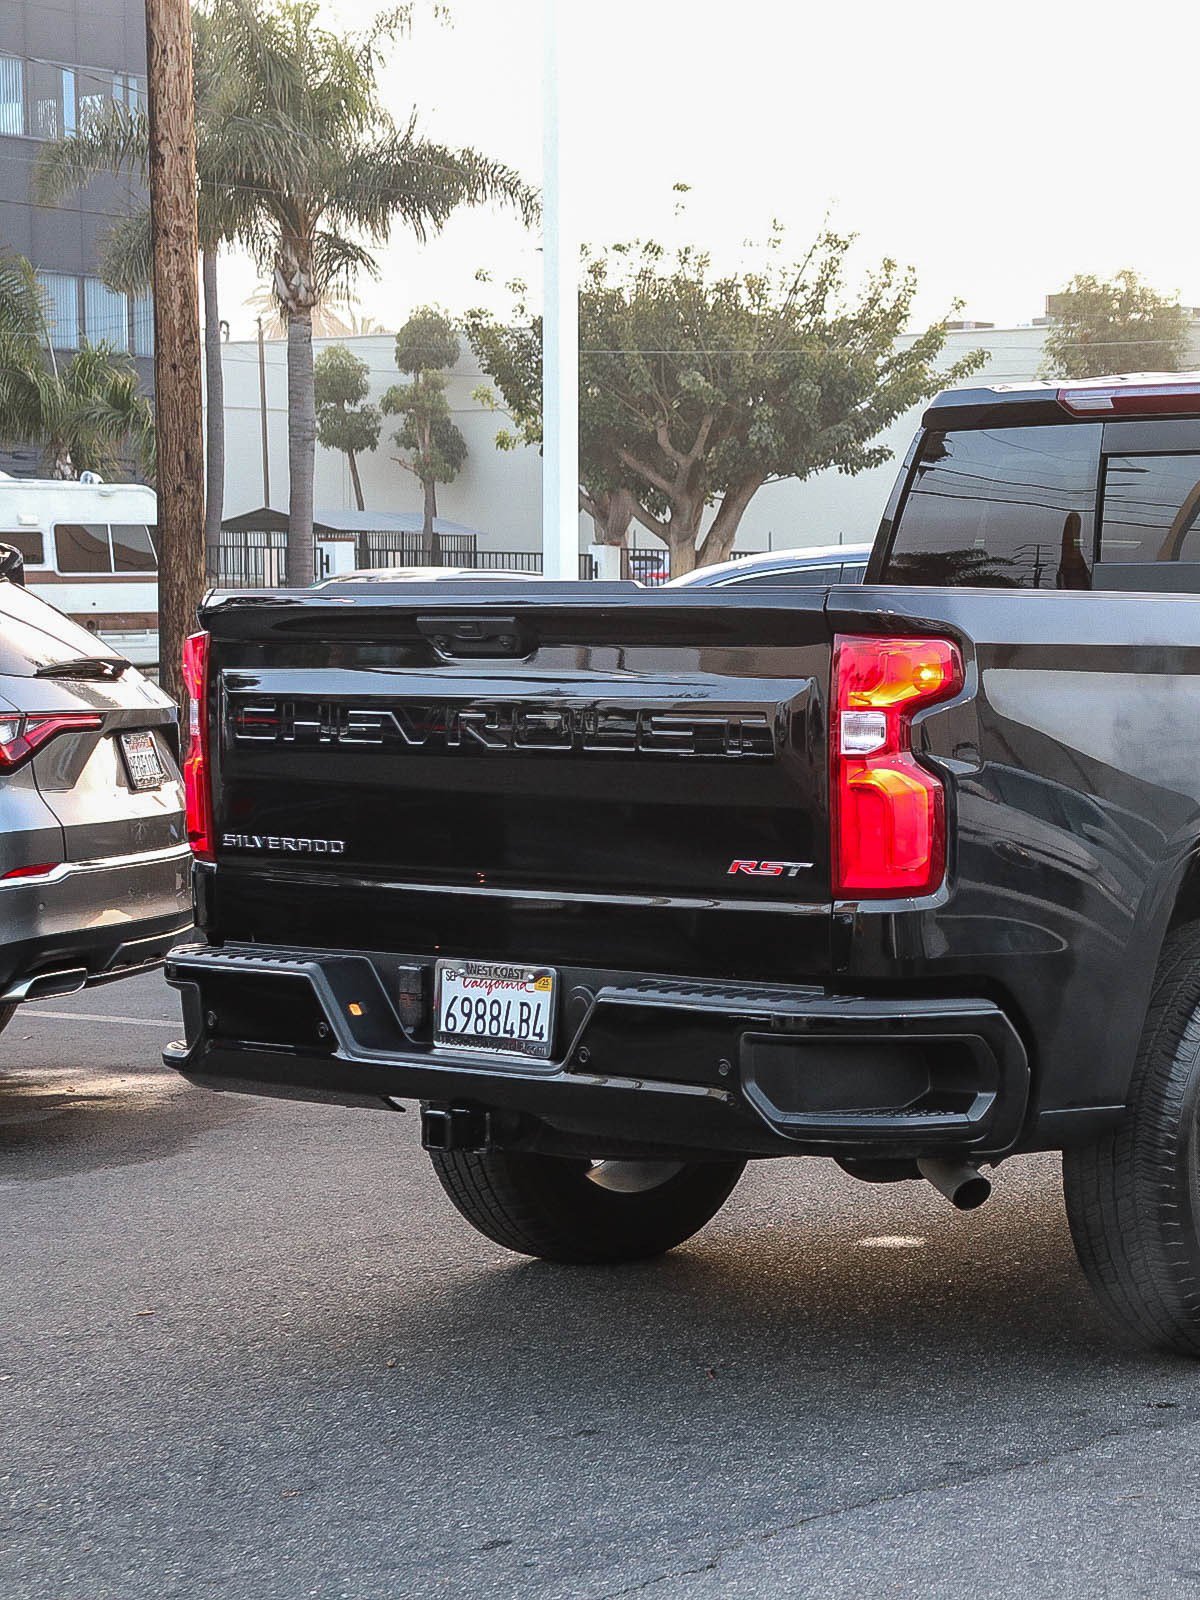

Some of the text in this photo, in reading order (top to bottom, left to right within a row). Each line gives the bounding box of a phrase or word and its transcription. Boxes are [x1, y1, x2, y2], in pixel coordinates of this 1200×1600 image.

[235, 703, 768, 755] CHEVROLET
[222, 833, 346, 853] SILVERADO
[727, 858, 815, 877] RST
[466, 962, 525, 980] WEST COAST
[462, 977, 536, 996] California
[444, 995, 545, 1040] 69884B4
